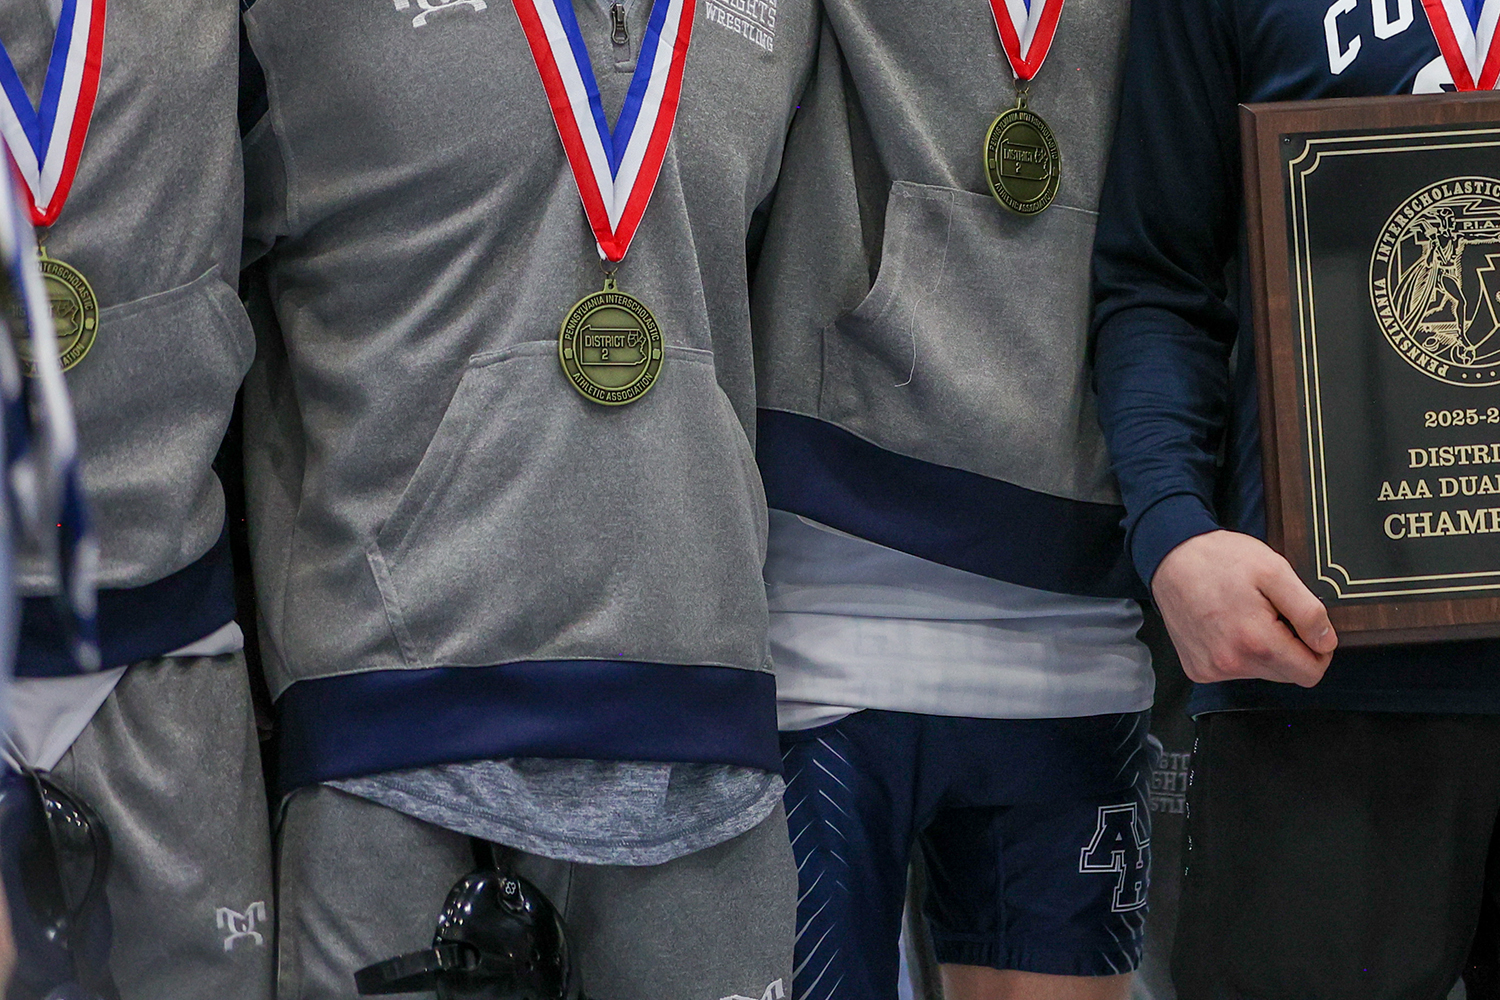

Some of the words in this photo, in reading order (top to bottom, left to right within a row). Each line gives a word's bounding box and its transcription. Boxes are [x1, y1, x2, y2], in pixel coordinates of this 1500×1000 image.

[705, 1, 774, 53] WRESTLING
[564, 295, 605, 341] PENNSYLVANIA
[605, 294, 660, 341] INTERSCHOLASTIC
[1373, 277, 1450, 377] PENNSYLVANIA
[584, 335, 625, 348] DISTRICT
[601, 347, 609, 360] 2
[572, 372, 606, 401] ATHLETIC
[606, 372, 654, 402] ASSOCIATION
[1377, 478, 1433, 502] AAA
